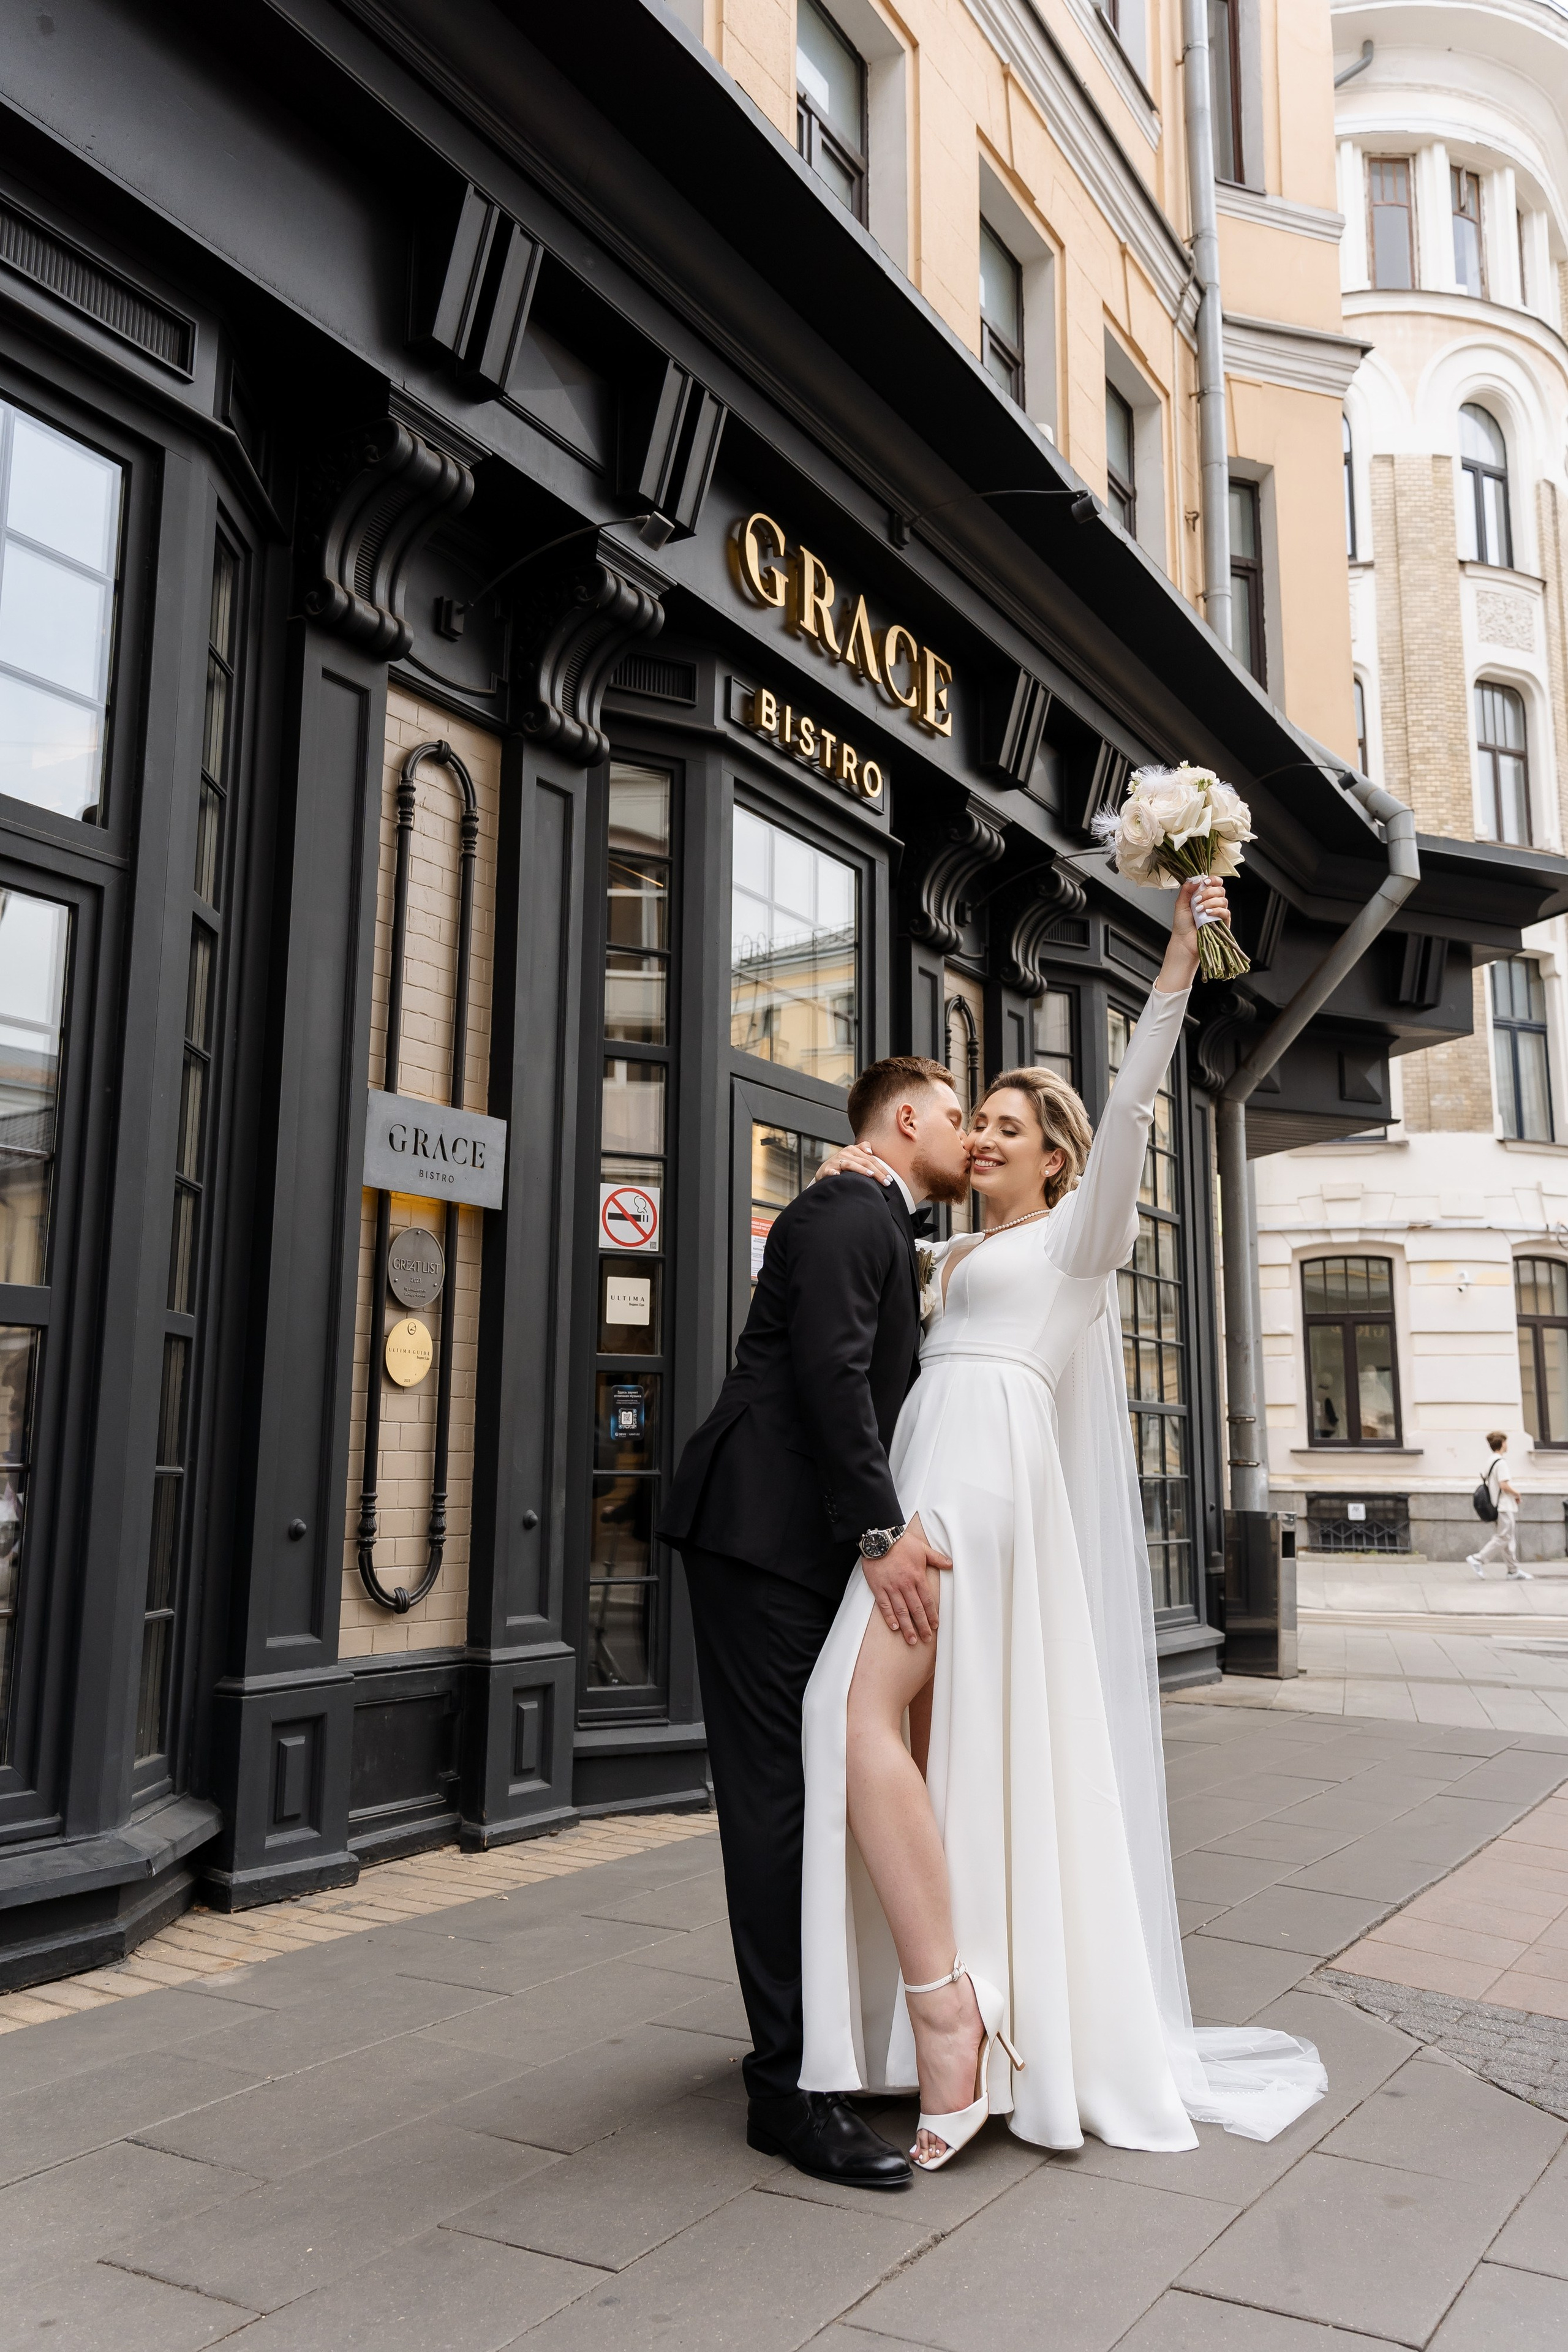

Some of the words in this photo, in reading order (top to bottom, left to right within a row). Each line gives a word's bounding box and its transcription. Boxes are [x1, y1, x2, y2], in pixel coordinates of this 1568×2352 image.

[741, 513, 952, 737] GRACE
[756, 688, 882, 797] BISTRO
[389, 1124, 486, 1169] GRACE
[419, 1169, 454, 1183] BISTRO
[393, 1257, 421, 1272] GREAT
[422, 1262, 440, 1274] LIST
